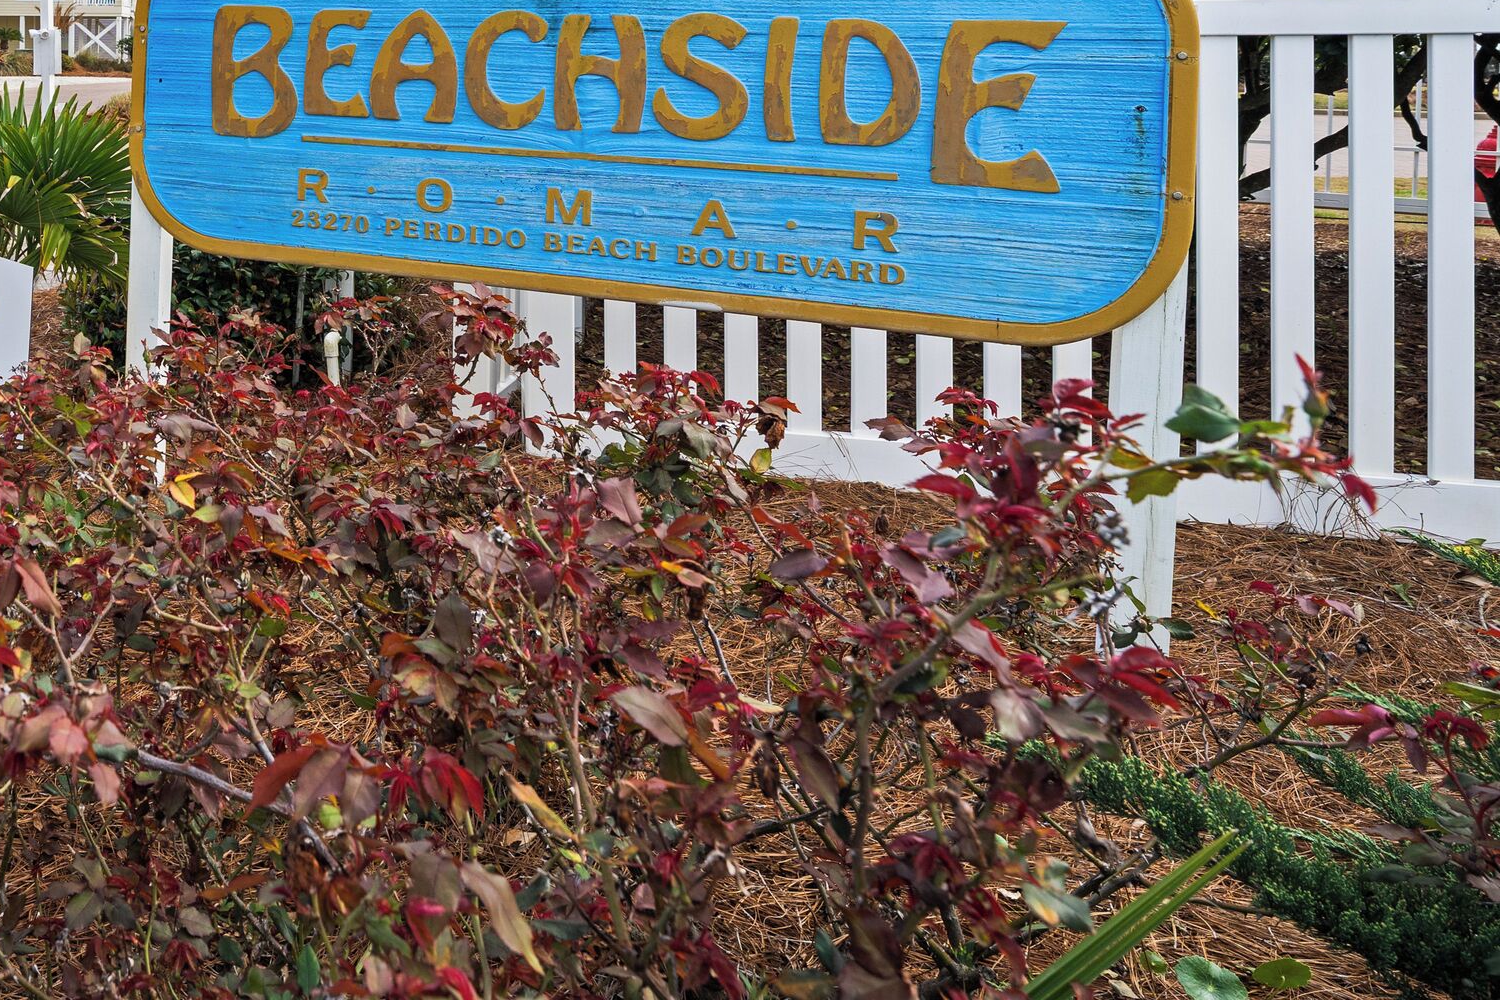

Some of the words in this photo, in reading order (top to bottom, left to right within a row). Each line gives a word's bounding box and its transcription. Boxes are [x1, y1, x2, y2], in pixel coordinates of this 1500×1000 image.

[211, 3, 1069, 194] BEACHSIDE
[291, 210, 370, 233] 23270
[385, 217, 527, 248] PERDIDO
[543, 231, 658, 262] BEACH
[676, 244, 905, 285] BOULEVARD
